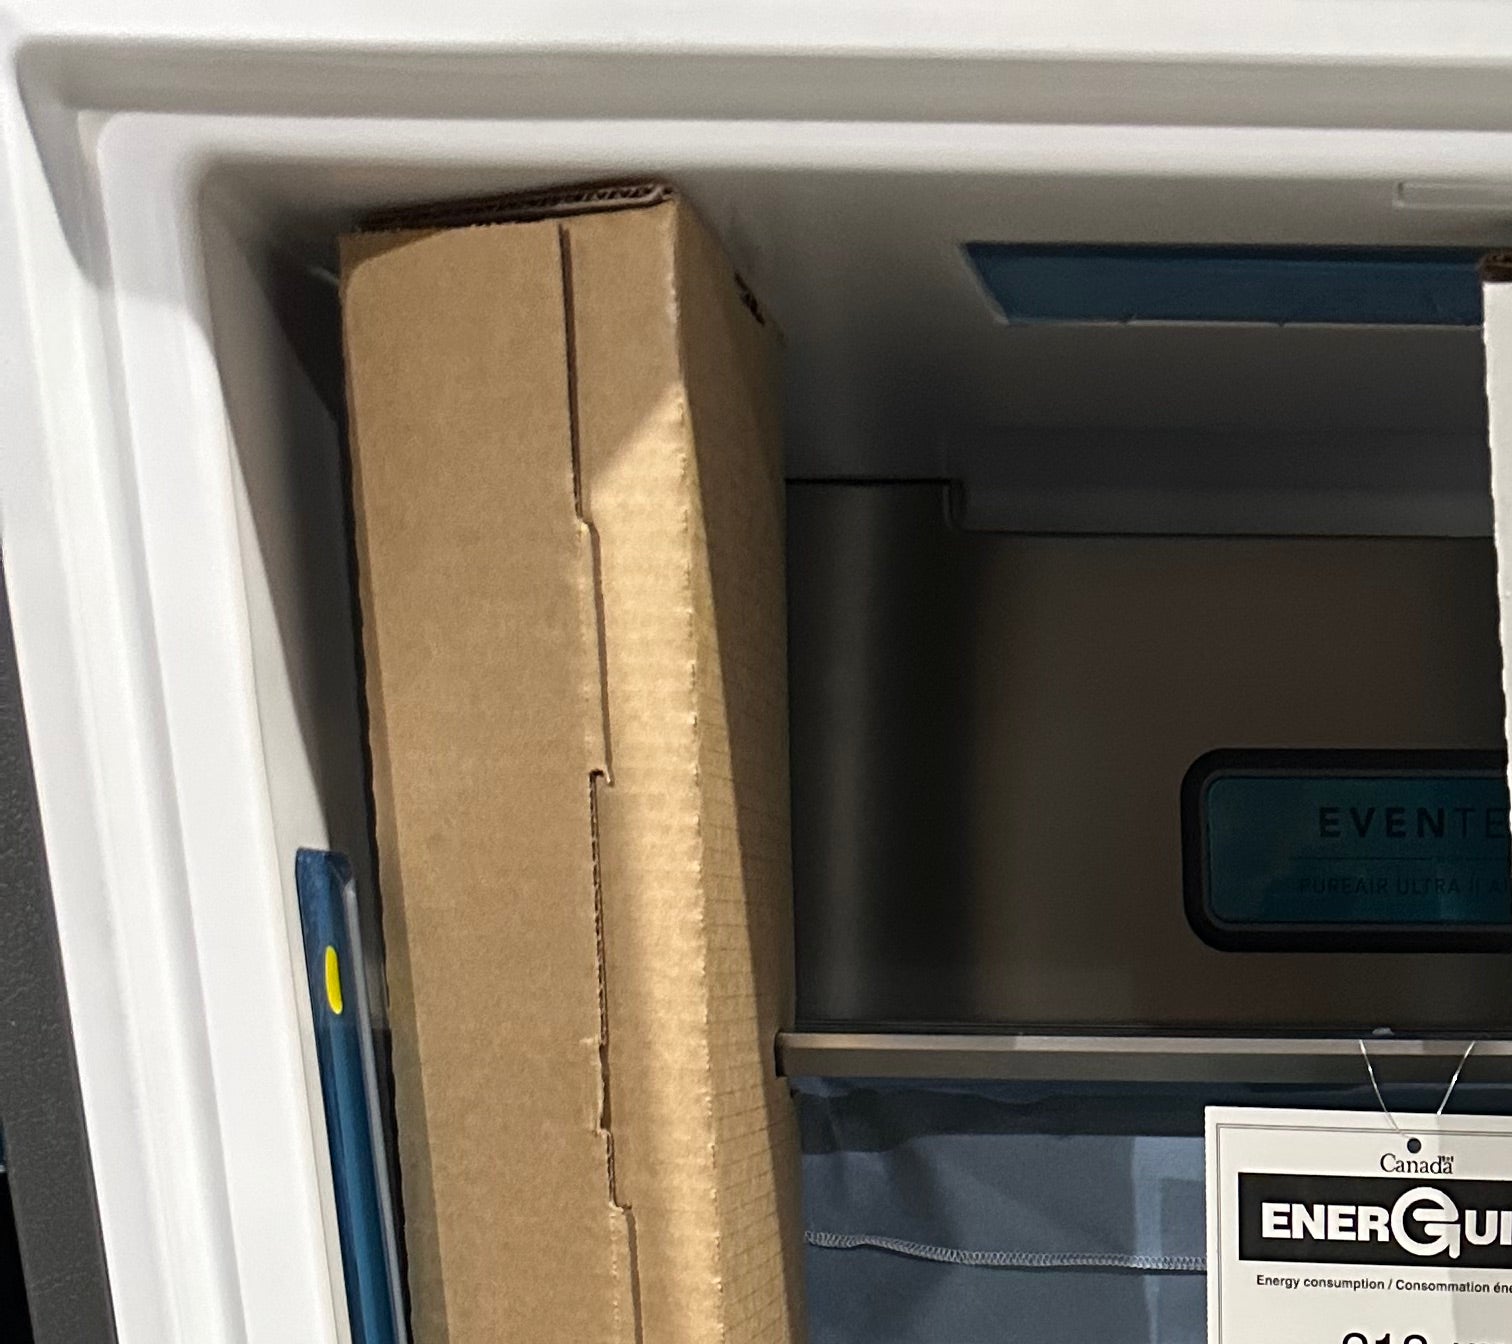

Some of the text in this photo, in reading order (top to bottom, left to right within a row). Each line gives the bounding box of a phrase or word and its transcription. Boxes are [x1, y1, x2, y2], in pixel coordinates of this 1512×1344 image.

[1319, 807, 1506, 838] EVENTE
[1300, 878, 1387, 894] PUREAIR
[1397, 879, 1459, 894] ULTRA
[1380, 1153, 1454, 1174] Canada
[1256, 1274, 1300, 1289] Energy
[1303, 1277, 1385, 1291] consumption
[1388, 1279, 1392, 1290] /
[1396, 1280, 1490, 1294] Consommation
